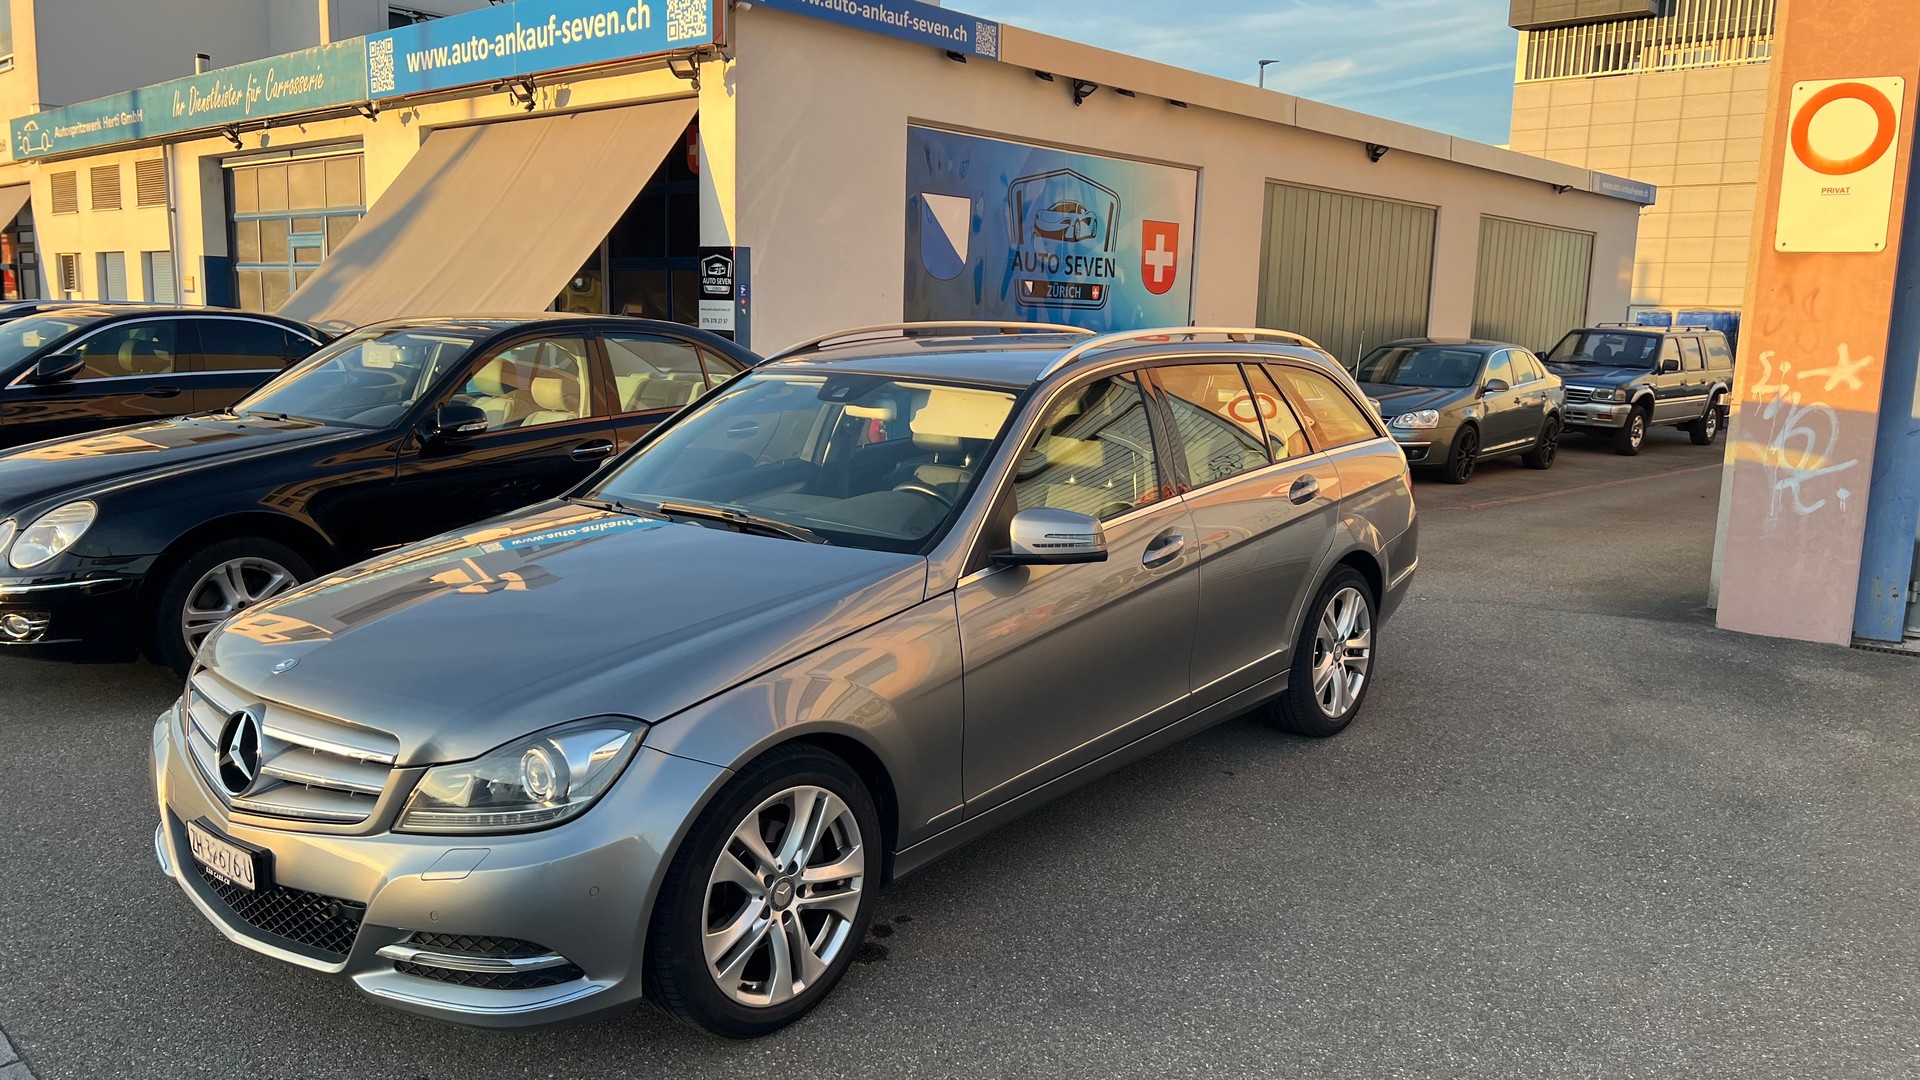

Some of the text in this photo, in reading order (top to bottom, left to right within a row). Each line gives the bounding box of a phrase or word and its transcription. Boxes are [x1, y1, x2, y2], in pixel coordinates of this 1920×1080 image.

[407, 0, 650, 72] www.auto-ankauf-seven.ch
[172, 65, 325, 118] Ihr Dienstleister für Carrosserie
[120, 108, 144, 126] GmbH
[1011, 250, 1116, 278] AUTO SEVEN
[702, 277, 731, 285] AUTO SEVEN
[1046, 283, 1082, 299] ZÜRICH
